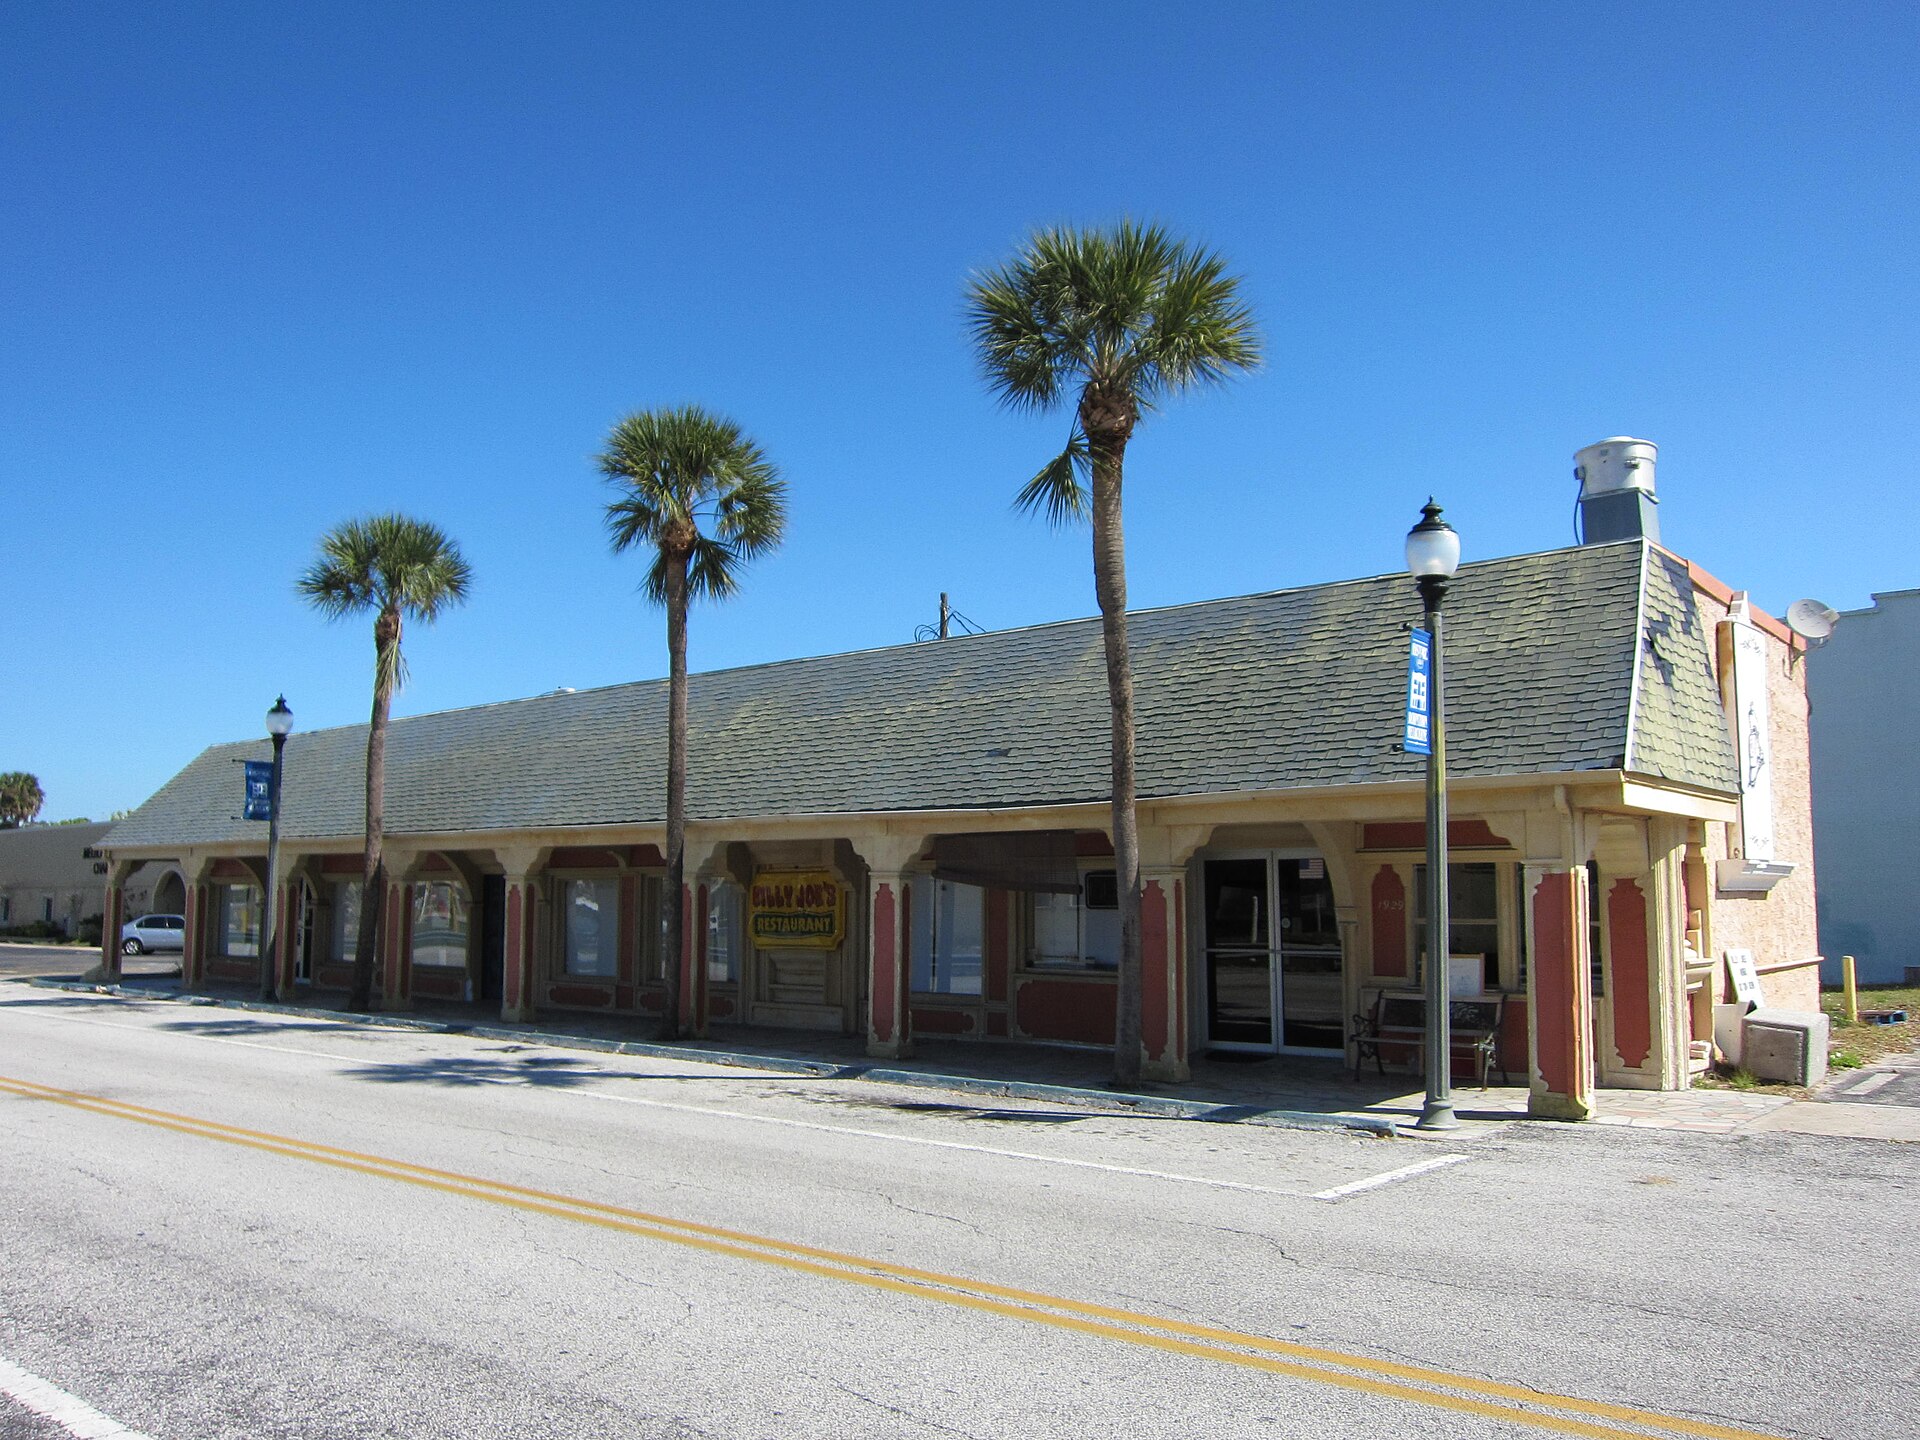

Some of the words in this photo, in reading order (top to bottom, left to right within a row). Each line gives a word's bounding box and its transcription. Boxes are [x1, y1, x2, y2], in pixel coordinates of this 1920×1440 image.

[752, 885, 793, 908] BILLY
[797, 882, 836, 908] JOE'S
[1378, 899, 1404, 911] 1929
[757, 917, 831, 932] RESTAURANT
